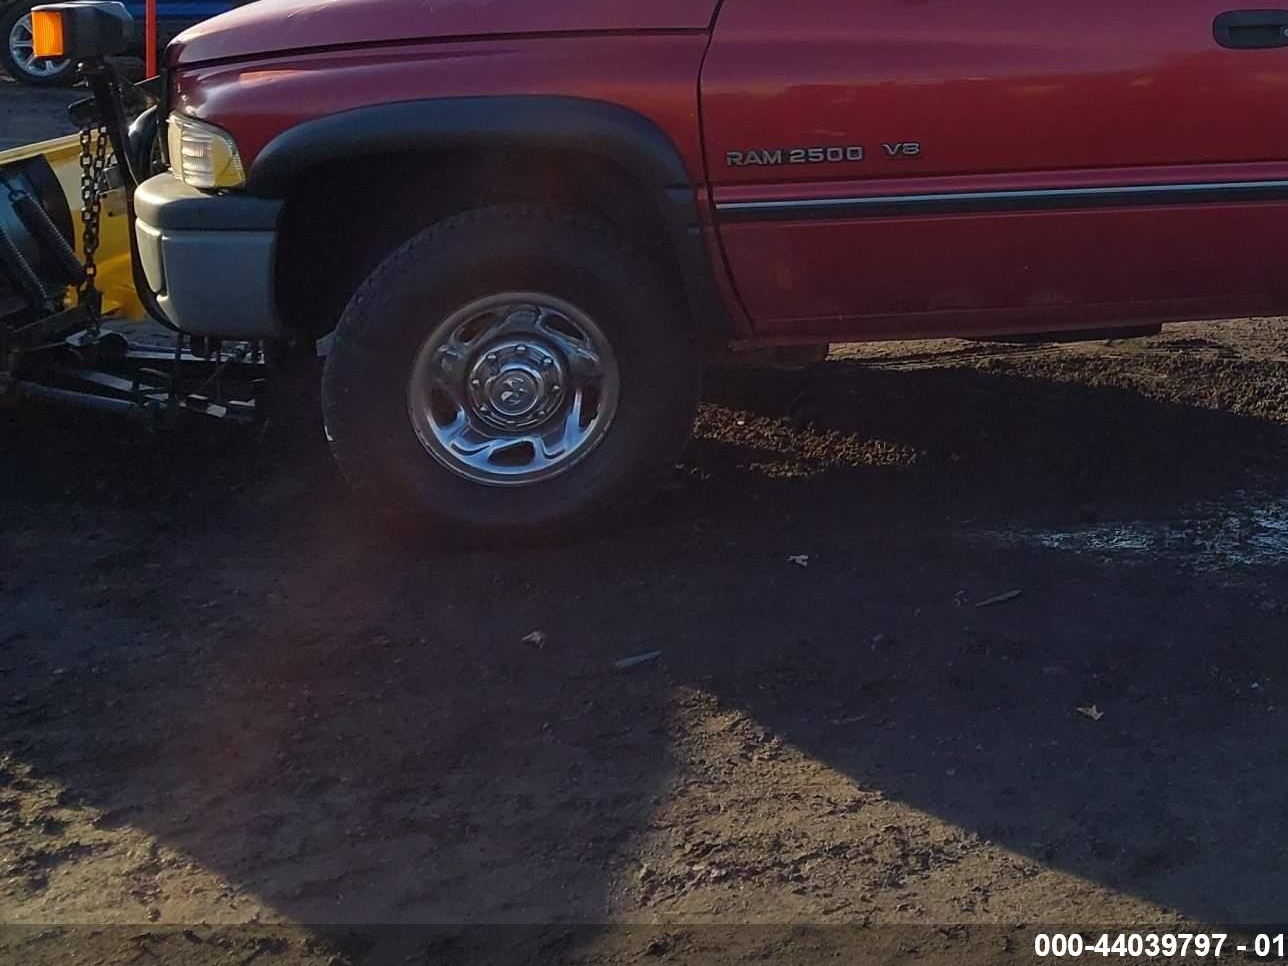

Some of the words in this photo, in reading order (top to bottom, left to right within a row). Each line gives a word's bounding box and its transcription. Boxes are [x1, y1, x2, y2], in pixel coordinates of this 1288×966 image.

[726, 150, 783, 167] RAM
[789, 146, 864, 163] 2500
[882, 142, 921, 155] V8
